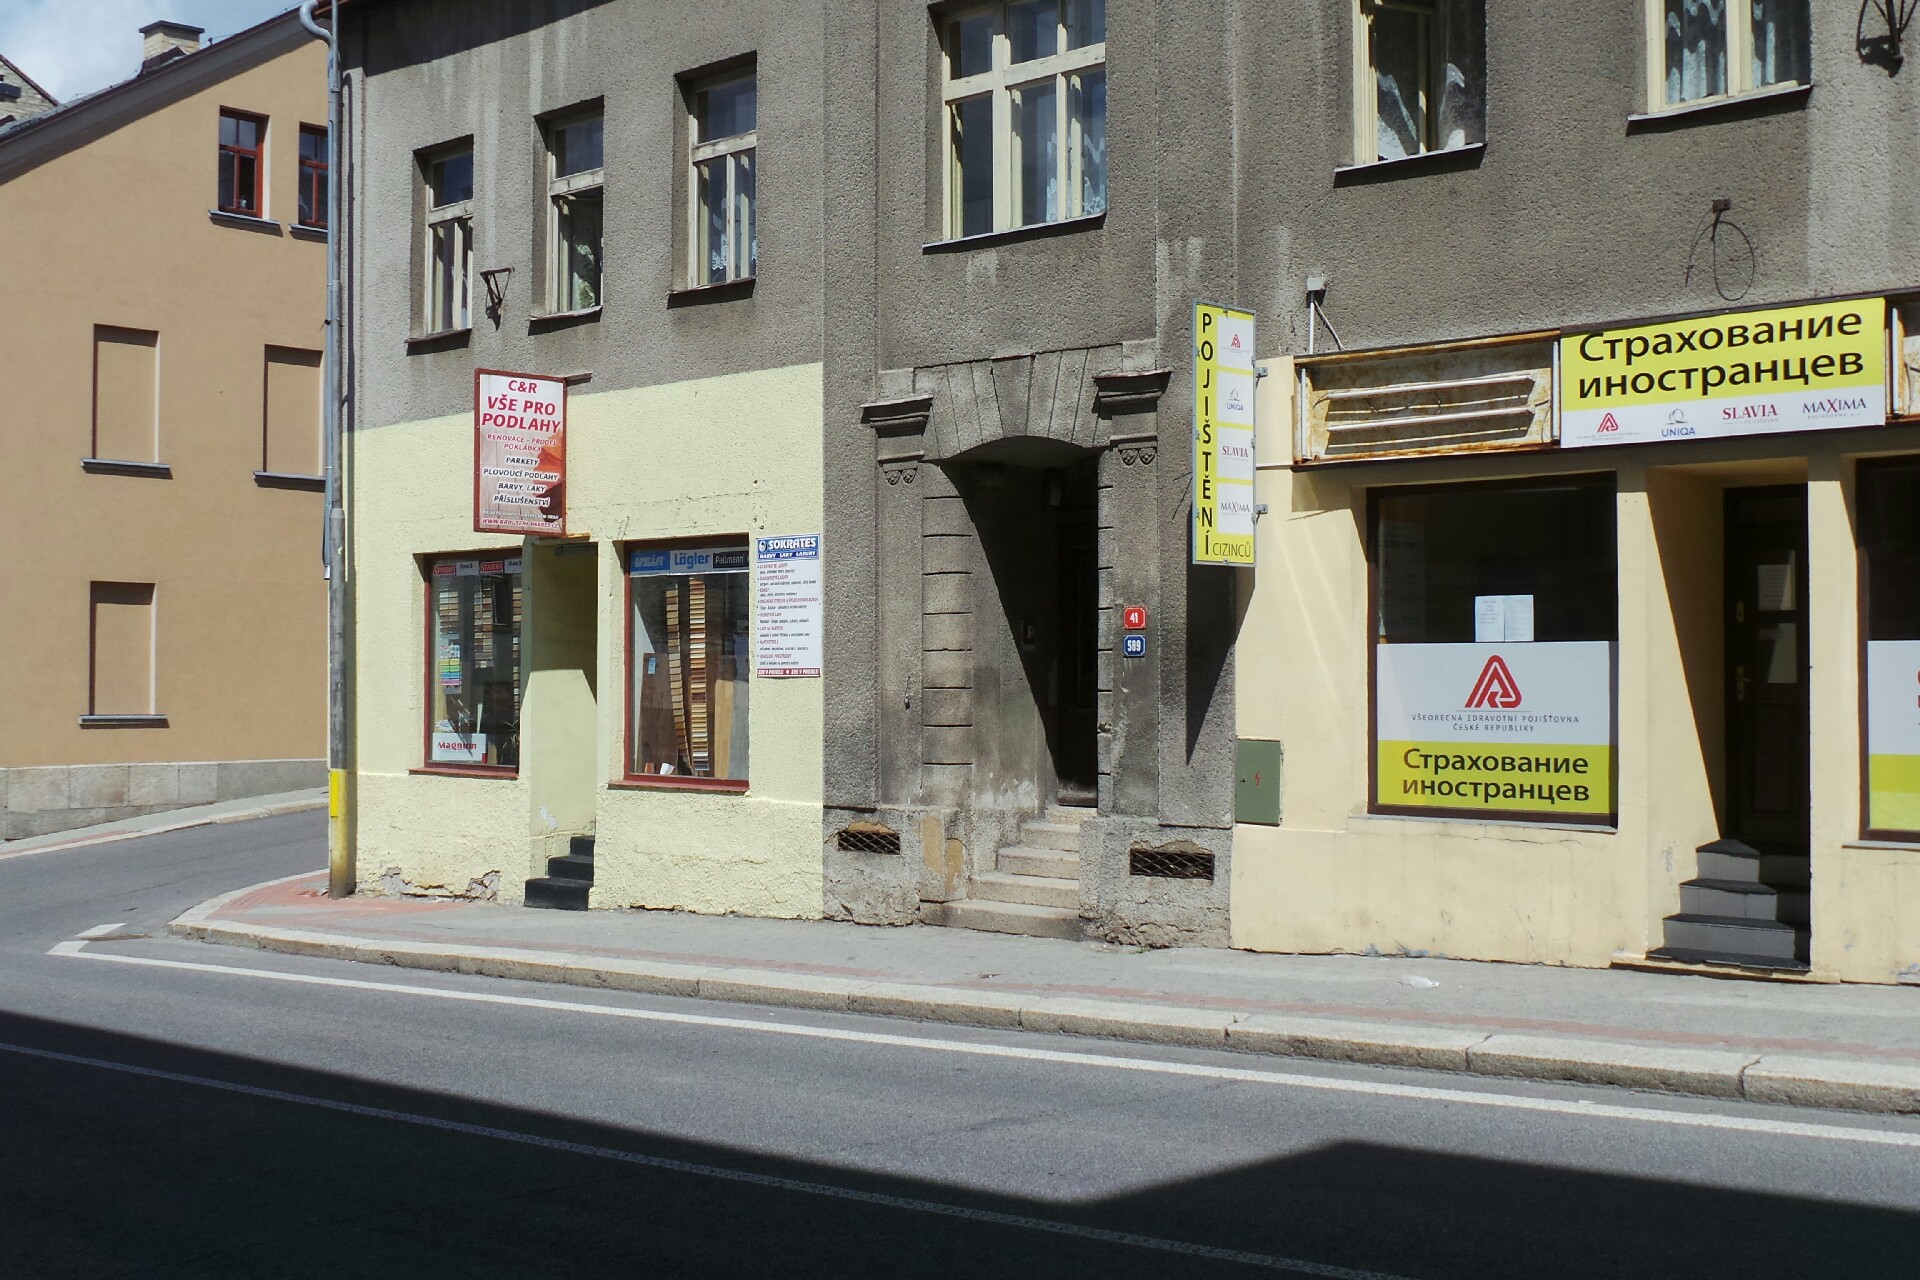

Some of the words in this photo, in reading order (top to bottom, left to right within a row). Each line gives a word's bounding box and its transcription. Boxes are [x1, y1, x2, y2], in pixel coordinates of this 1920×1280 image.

[1579, 313, 1862, 365] Страхование
[1579, 352, 1864, 399] иностранцев
[508, 380, 538, 394] C&R
[487, 393, 518, 411] VŠE
[523, 400, 556, 416] PRO
[1226, 402, 1244, 411] UNIQA
[1802, 398, 1867, 414] MAXIMA
[1722, 404, 1778, 421] SLAVIA
[481, 412, 561, 433] PODLAHY
[487, 433, 525, 443] RENOVACE
[1200, 312, 1214, 555] POJIŠTĚNÍ
[1661, 427, 1696, 437] UNIQA
[503, 443, 541, 452] POKLÁDKA
[1222, 445, 1249, 458] SLAVIA
[506, 457, 539, 466] PARKETY
[483, 468, 523, 477] PLOVOUCÍ
[524, 471, 558, 480] PODLAHY
[498, 483, 524, 491] BARVY,
[493, 494, 550, 505] PŘÍSLUŠENSTVÍ
[1220, 502, 1250, 513] MAXIMA
[768, 537, 817, 550] SOKRATES
[1212, 541, 1251, 558] CIZINCŮ
[674, 552, 710, 570] Lägler
[715, 555, 744, 565] Pallmann
[1130, 612, 1139, 624] 41
[1127, 640, 1141, 652] 589
[1411, 713, 1463, 722] VŠEOBECNÁ
[1466, 714, 1517, 723] ZDRAVOTNÍ
[1522, 714, 1579, 724] POJIŠŤOVNA
[1453, 723, 1480, 732] ČESKÉ
[1484, 724, 1535, 733] REPUBLIKY
[438, 741, 477, 750] Magnum
[1403, 748, 1589, 775] Страхование
[1403, 779, 1590, 805] иностранцев
